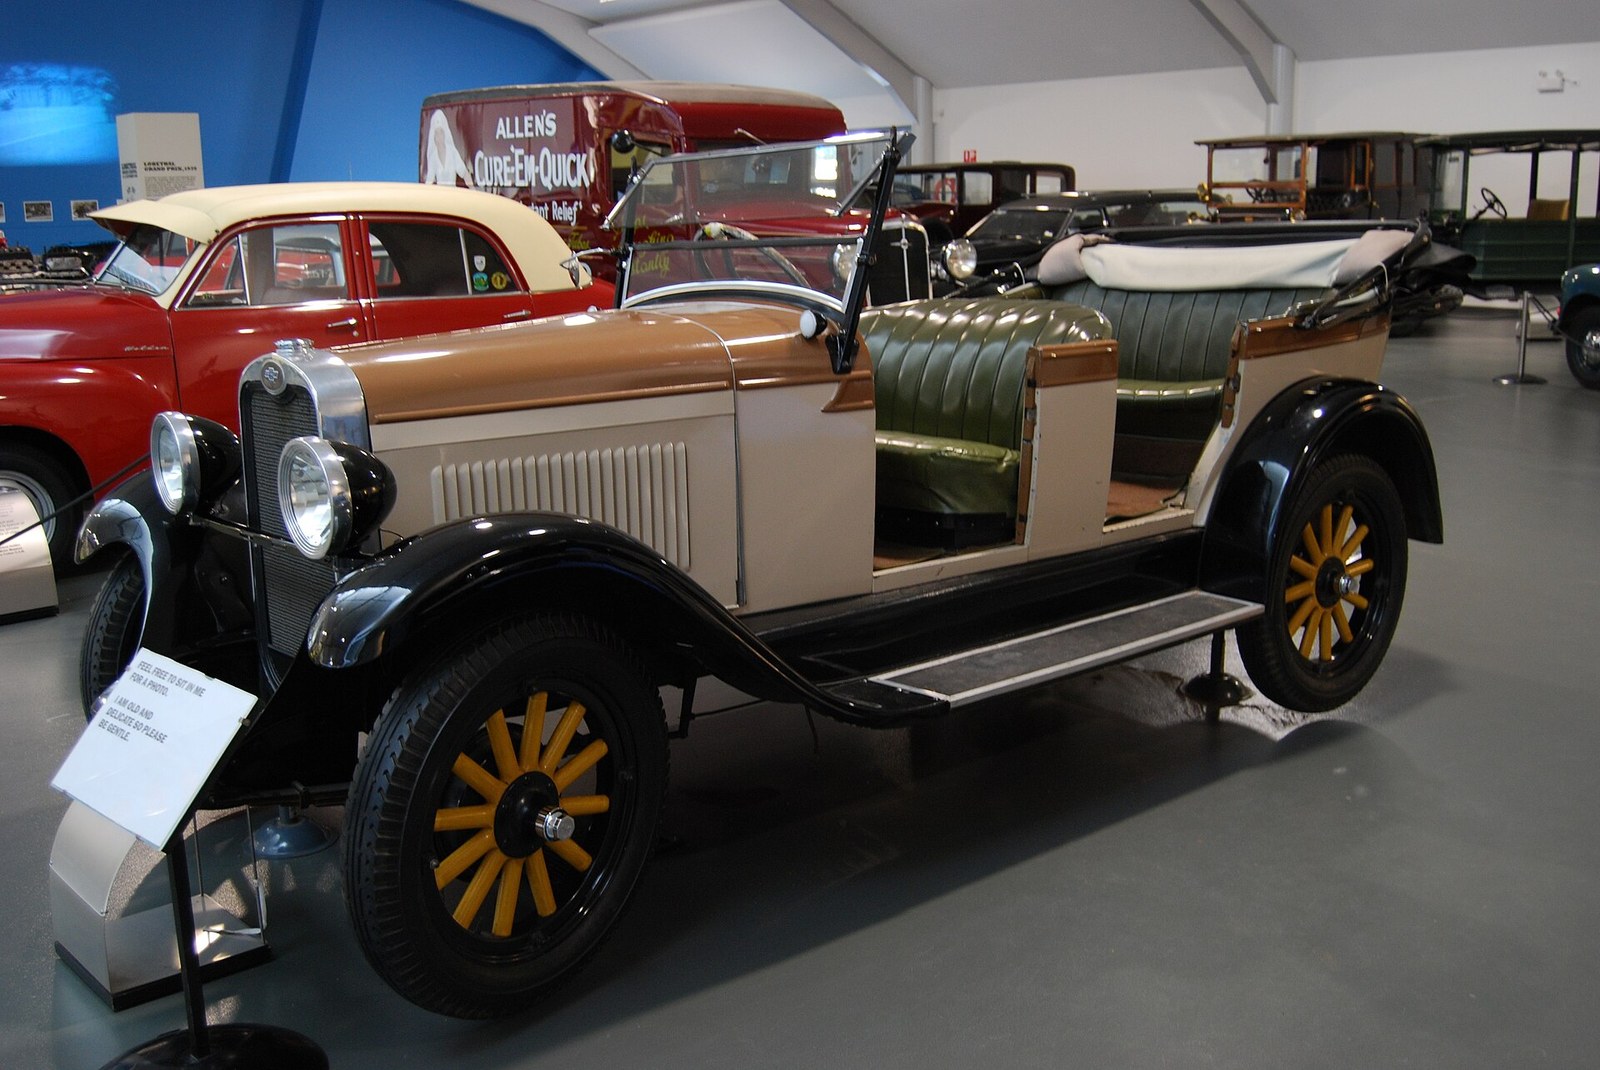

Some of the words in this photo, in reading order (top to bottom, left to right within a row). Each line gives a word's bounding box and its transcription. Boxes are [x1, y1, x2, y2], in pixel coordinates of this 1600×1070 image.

[495, 109, 557, 140] ALLEN'S
[130, 672, 144, 684] FOR
[142, 678, 149, 686] A
[146, 680, 169, 696] PHOTO.
[138, 661, 152, 672] FEEL
[151, 666, 169, 680] FREE
[167, 673, 178, 684] TO
[175, 678, 188, 689] SIT
[186, 682, 195, 693] IN
[193, 685, 206, 697] ME
[118, 696, 130, 707] AM
[126, 702, 140, 714] OLD
[138, 708, 154, 720] AND
[98, 718, 109, 729] BE
[106, 723, 130, 742] GENTLE.
[106, 707, 135, 727] DELICATE
[132, 720, 144, 731] SO
[142, 726, 168, 744] PLEASE
